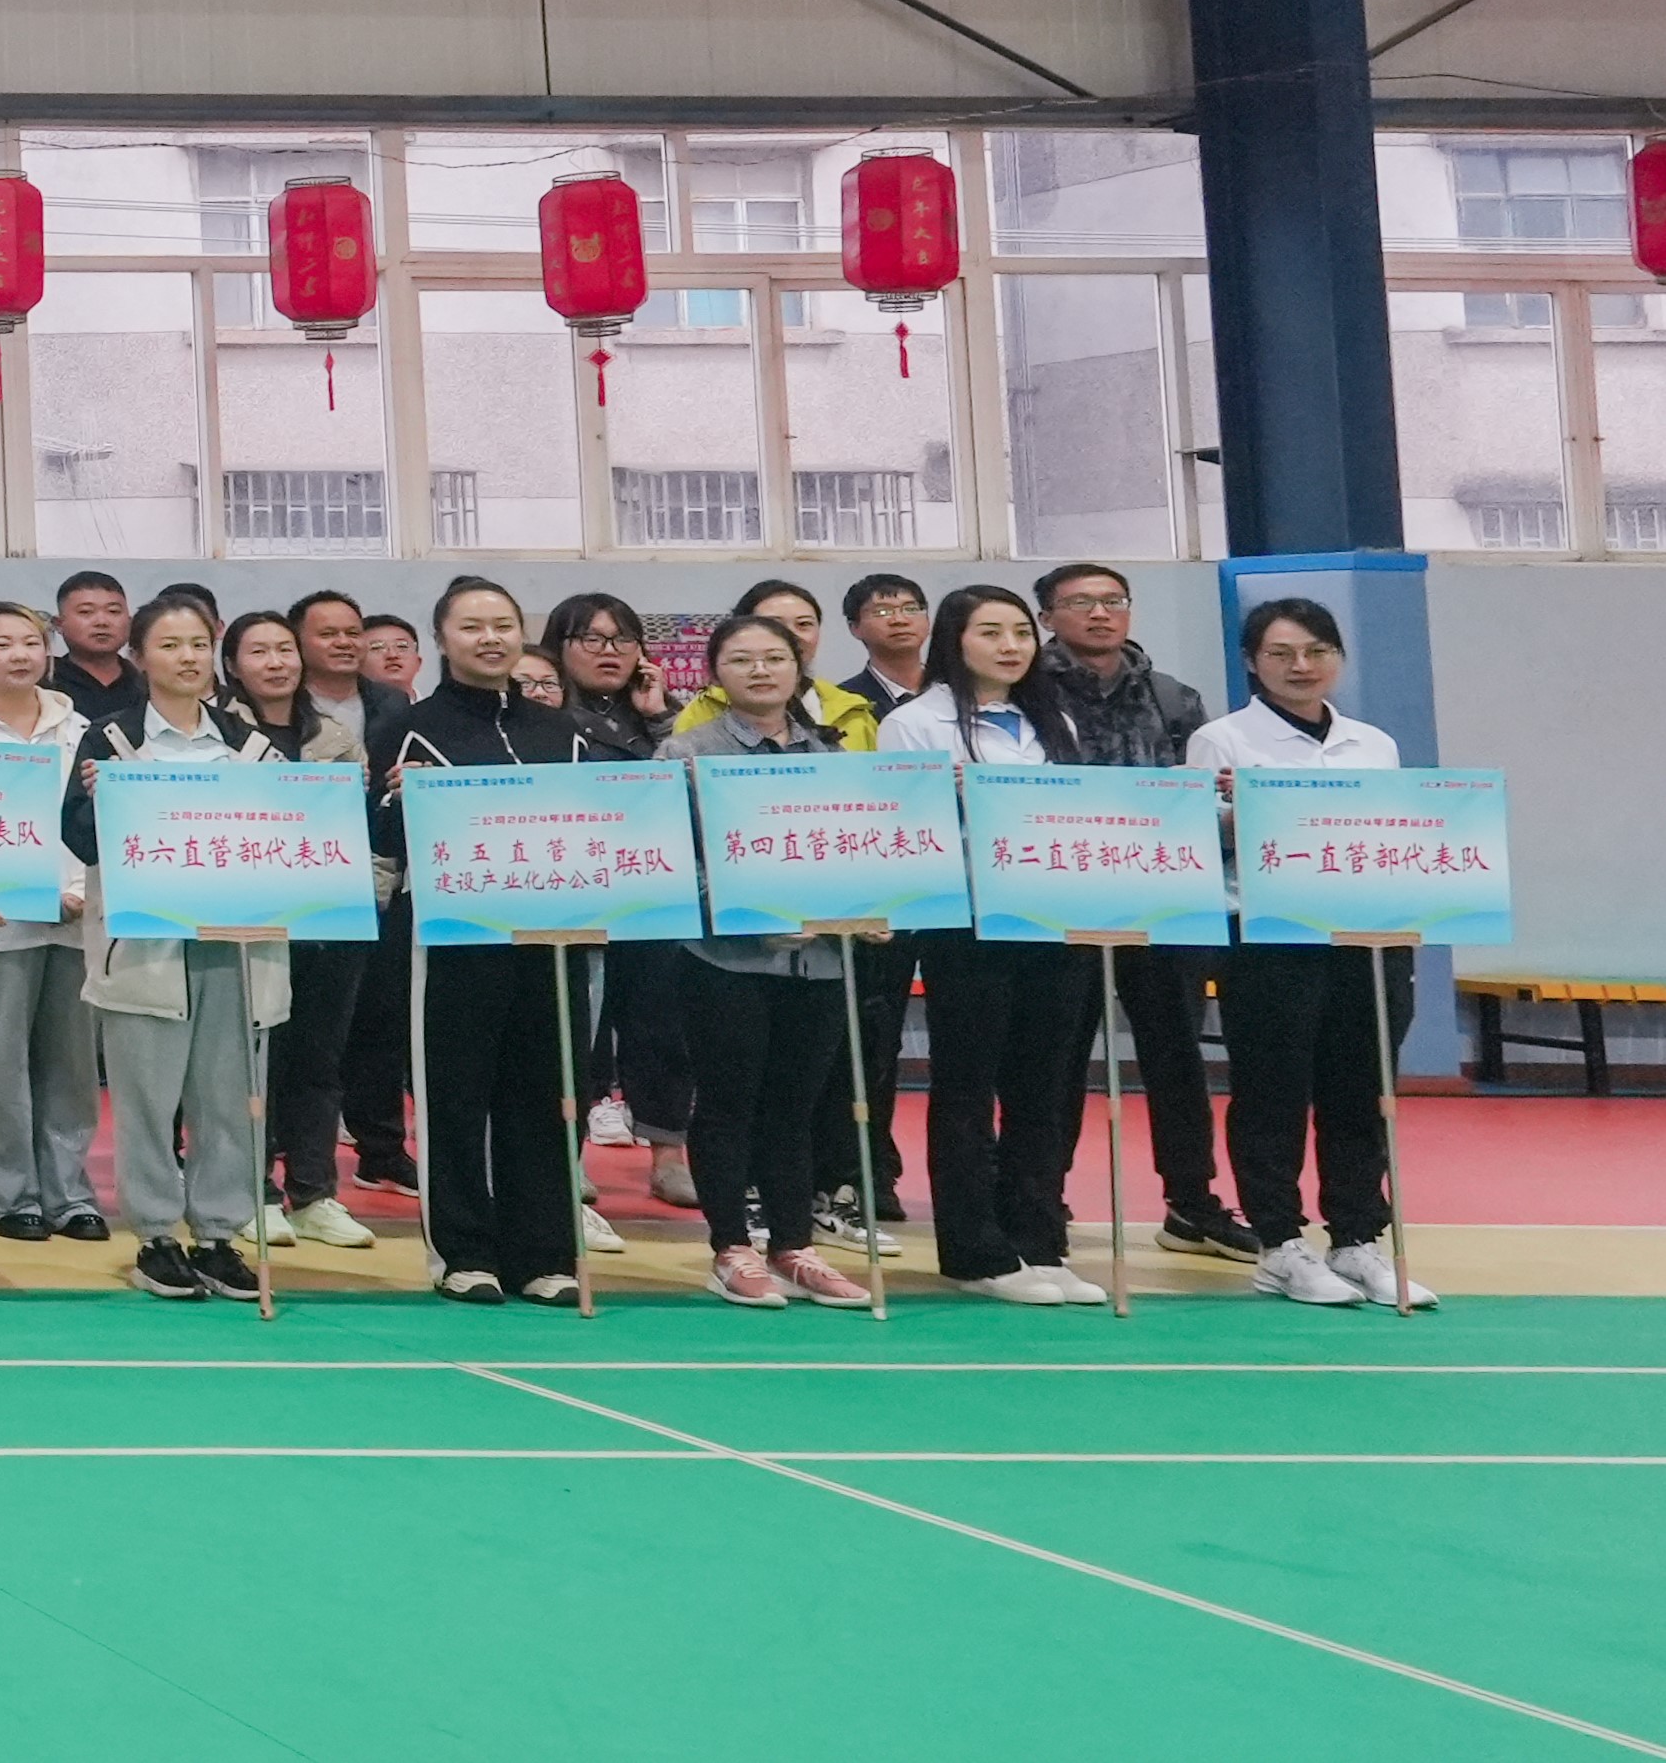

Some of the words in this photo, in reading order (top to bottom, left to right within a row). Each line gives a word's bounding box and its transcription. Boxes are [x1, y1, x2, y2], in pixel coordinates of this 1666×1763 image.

[122, 834, 351, 870] 第六直管部代表队
[432, 837, 607, 866] 第五直管部
[615, 848, 674, 875] 联队
[725, 826, 945, 864] 第四直管部代表队
[992, 837, 1204, 874] 第二直管部代表队
[1258, 839, 1490, 875] 第一直管部代表队
[435, 868, 610, 894] 建设产业化分公司
